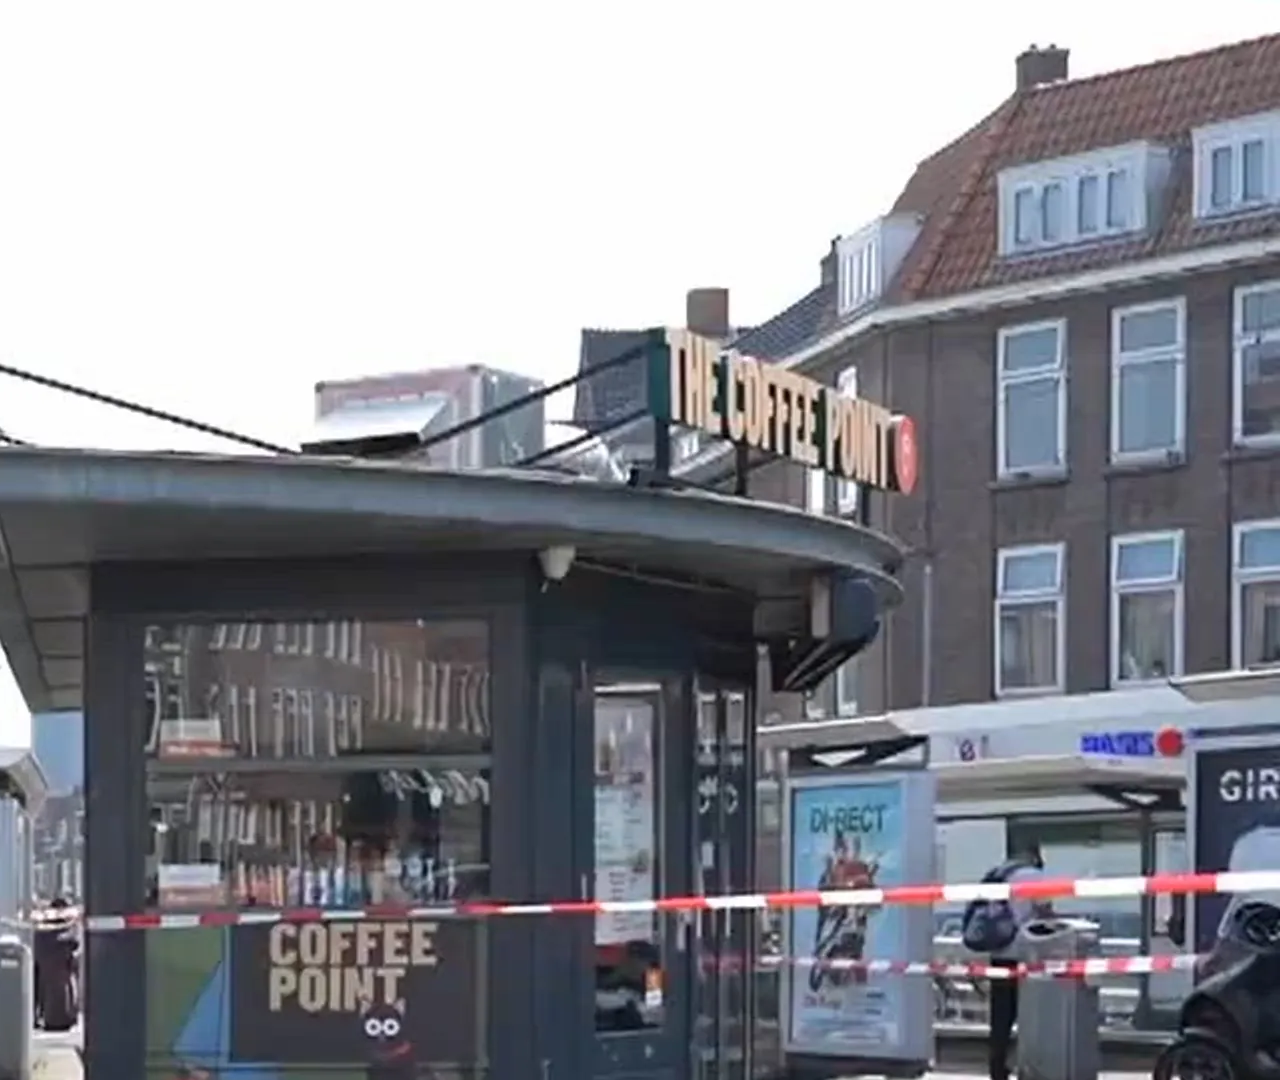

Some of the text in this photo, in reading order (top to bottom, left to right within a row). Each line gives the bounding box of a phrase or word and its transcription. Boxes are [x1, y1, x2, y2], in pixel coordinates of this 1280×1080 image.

[664, 326, 893, 490] THE COFFEE POINT
[809, 803, 887, 834] DI-RECT
[269, 922, 438, 966] COFFEE
[269, 967, 406, 1012] POINT
